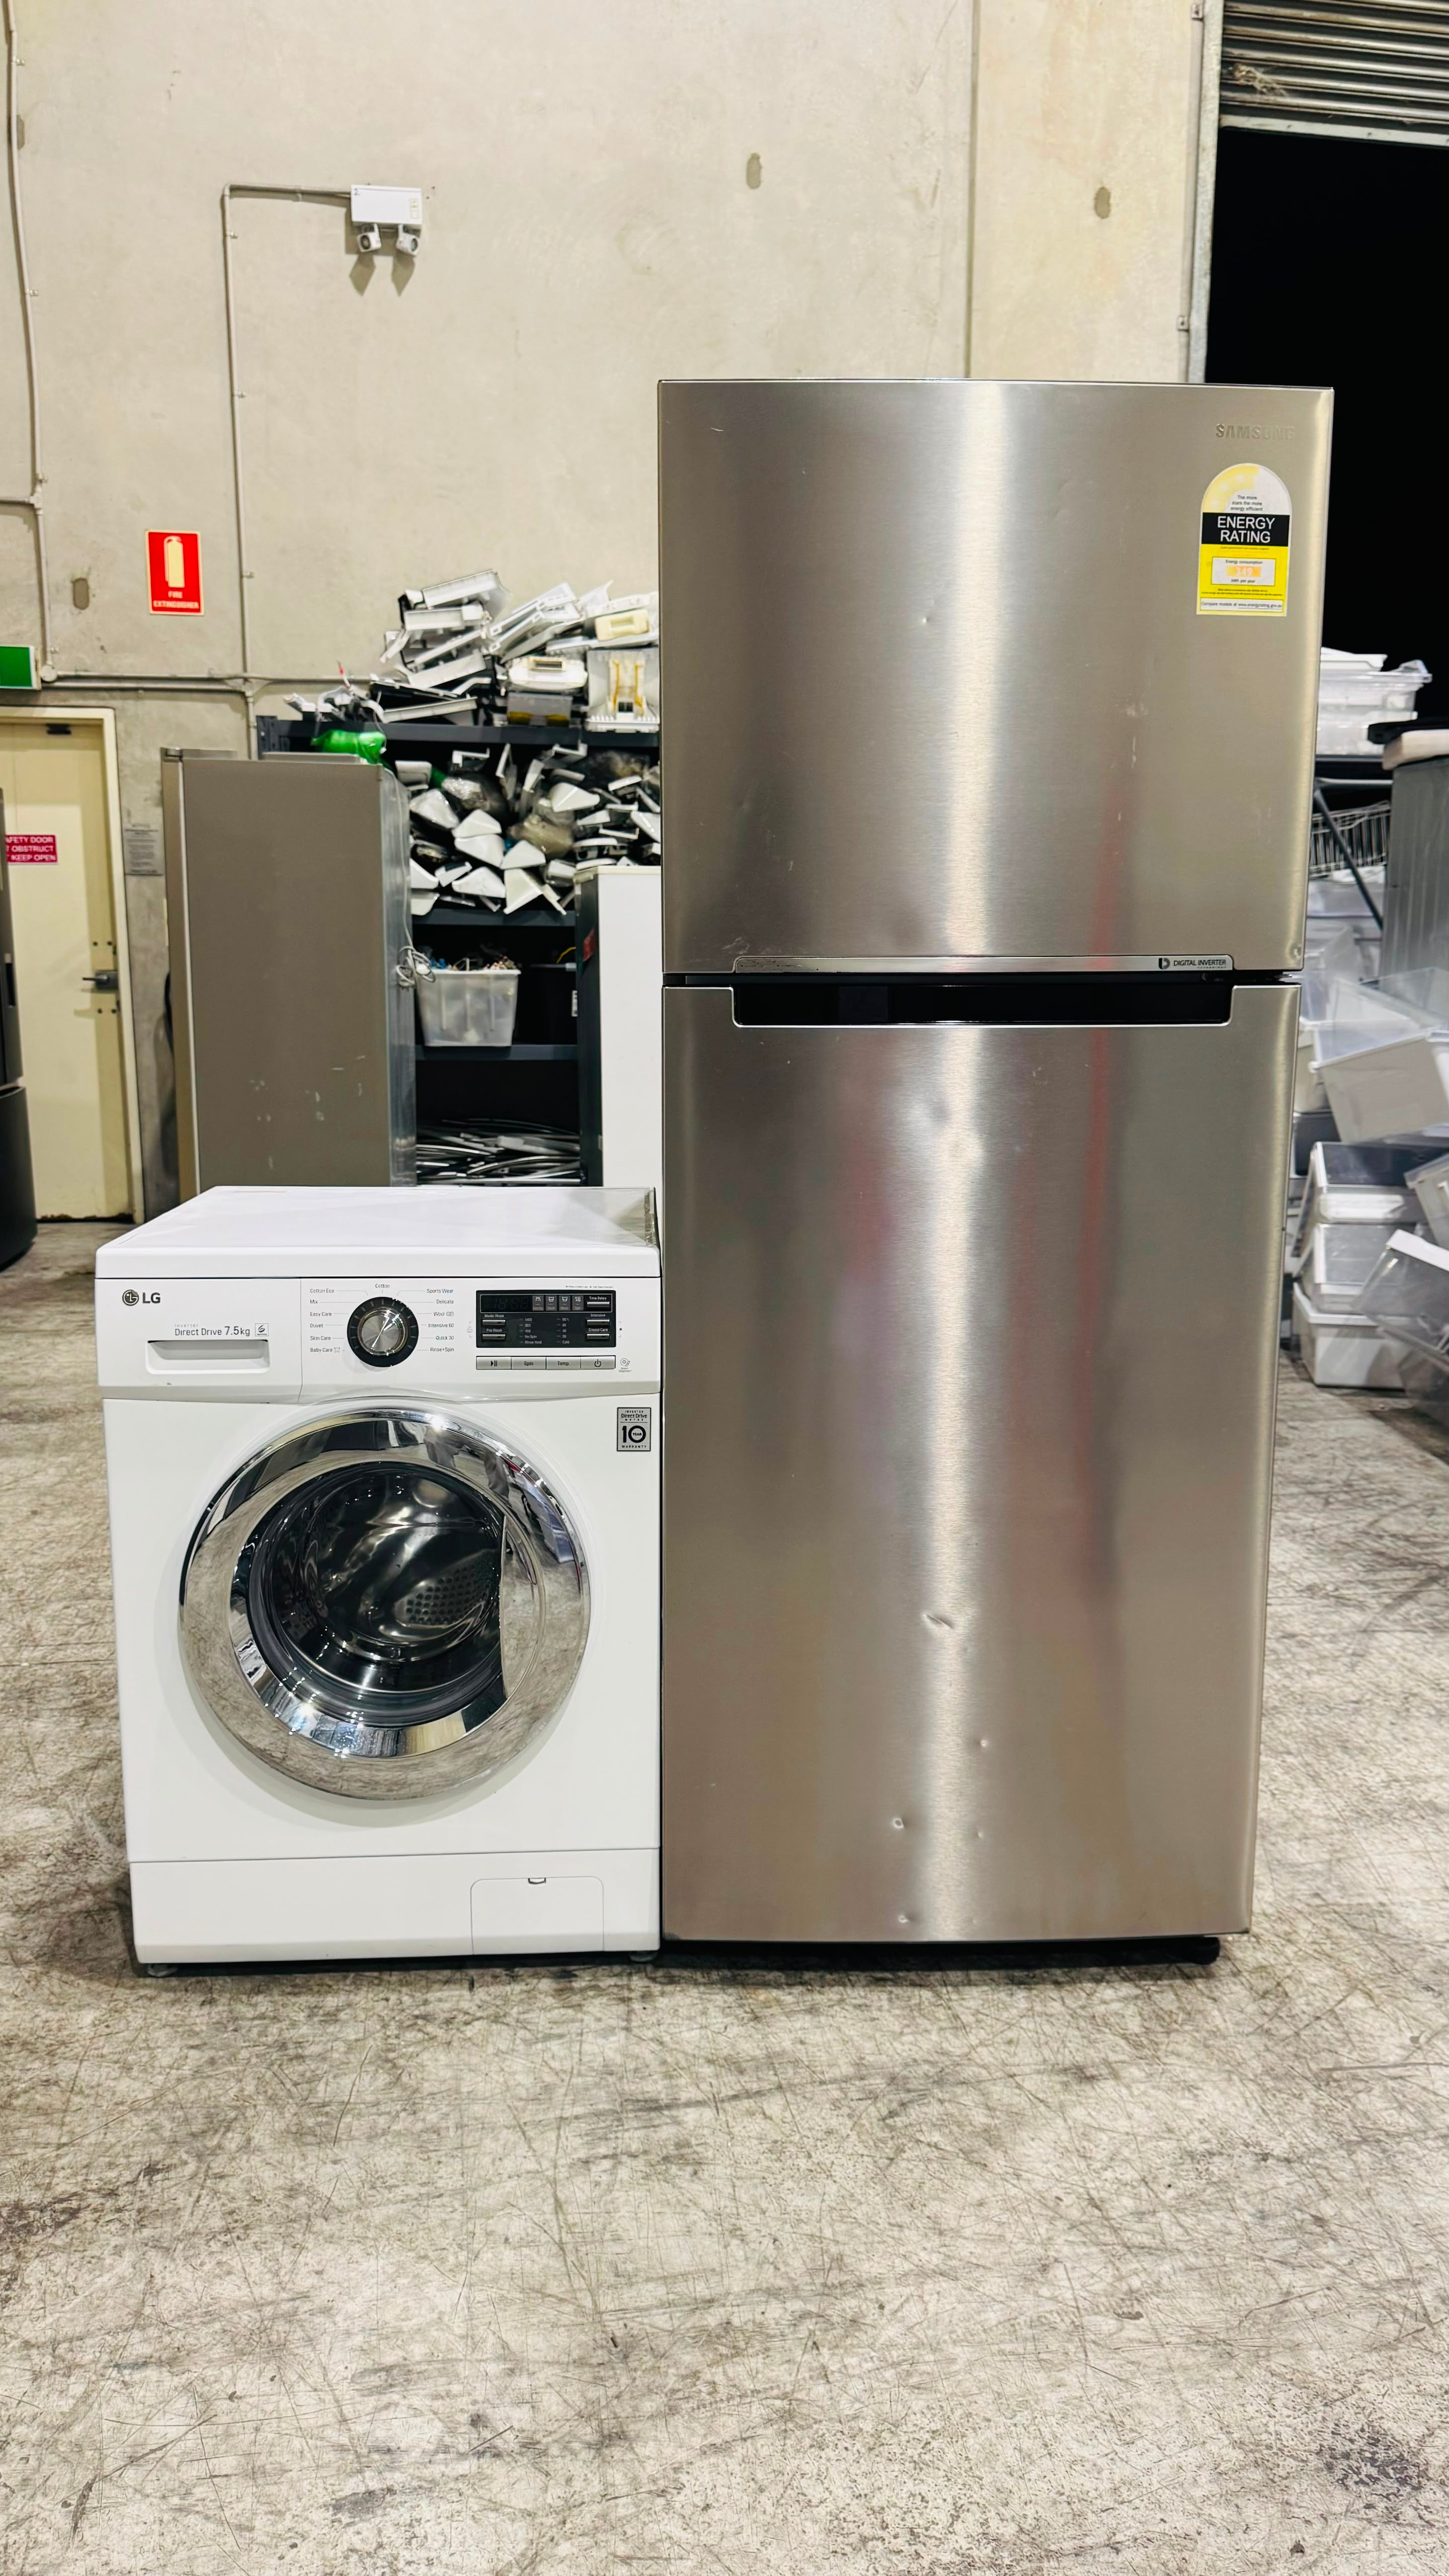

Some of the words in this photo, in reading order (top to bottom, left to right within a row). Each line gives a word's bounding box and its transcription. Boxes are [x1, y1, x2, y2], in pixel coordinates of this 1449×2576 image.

[1215, 424, 1295, 440] SAMSUNG
[1217, 515, 1275, 529] ENERGY
[1220, 530, 1271, 543] RATING
[168, 590, 183, 599] FIRE
[152, 600, 200, 609] EXTINGUISHER
[142, 1292, 161, 1304] LG
[175, 1328, 199, 1336] Direct
[201, 1328, 222, 1336] Drive
[622, 1425, 647, 1443] 10
